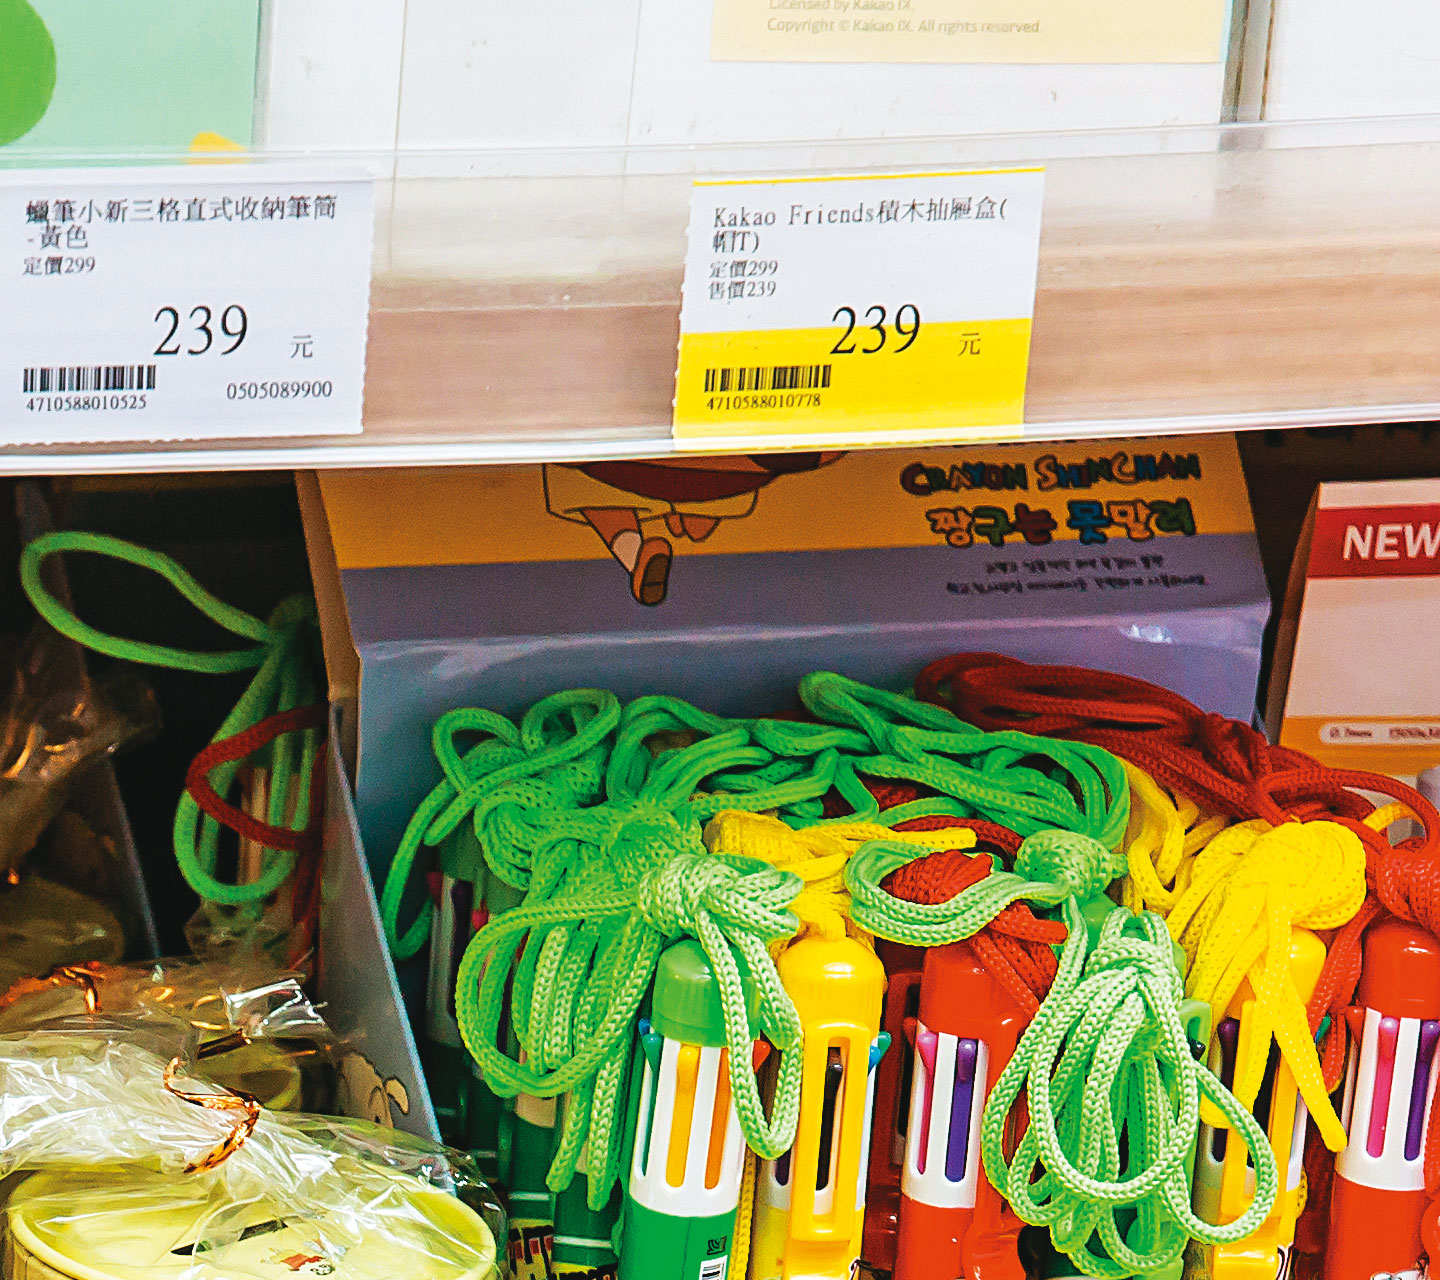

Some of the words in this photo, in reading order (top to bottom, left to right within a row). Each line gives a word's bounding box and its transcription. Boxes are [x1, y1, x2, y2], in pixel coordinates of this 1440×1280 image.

[767, 18, 834, 35] Copyright
[713, 204, 776, 228] Kakao
[153, 304, 250, 357] 239
[289, 333, 315, 359] 元
[831, 304, 921, 355] 239
[957, 332, 982, 357] 元
[227, 381, 334, 401] 0505089900
[26, 394, 147, 413] 4710588010525
